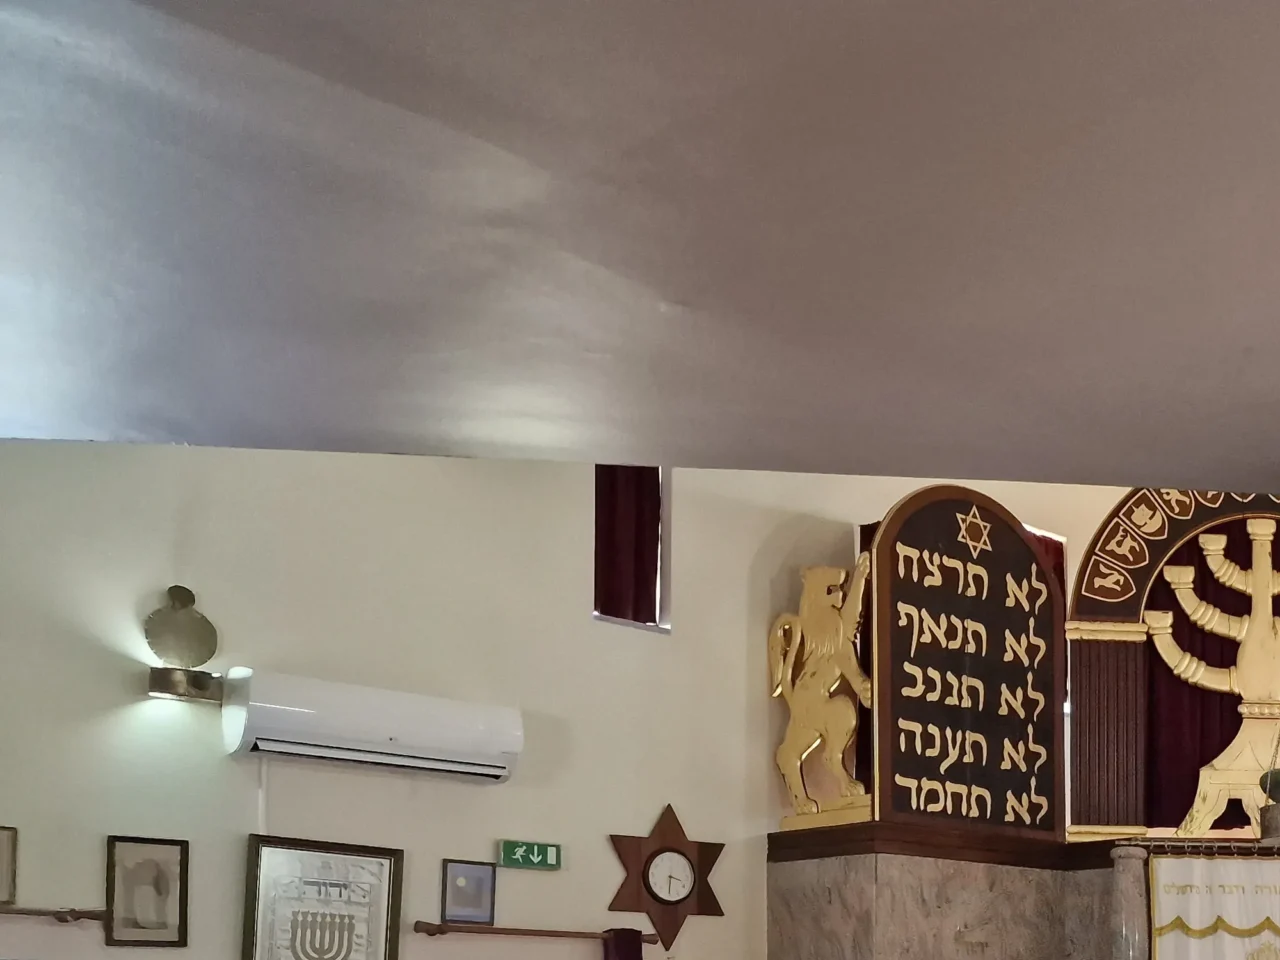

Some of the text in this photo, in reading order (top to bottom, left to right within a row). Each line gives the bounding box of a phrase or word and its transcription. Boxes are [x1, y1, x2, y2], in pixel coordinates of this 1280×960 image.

[896, 541, 1048, 615] לא תרצח
[897, 601, 1046, 669] לא תנאף
[901, 661, 1045, 722] לא תגנב
[897, 717, 1047, 775] לא תענה
[894, 773, 1048, 825] לא תחמד
